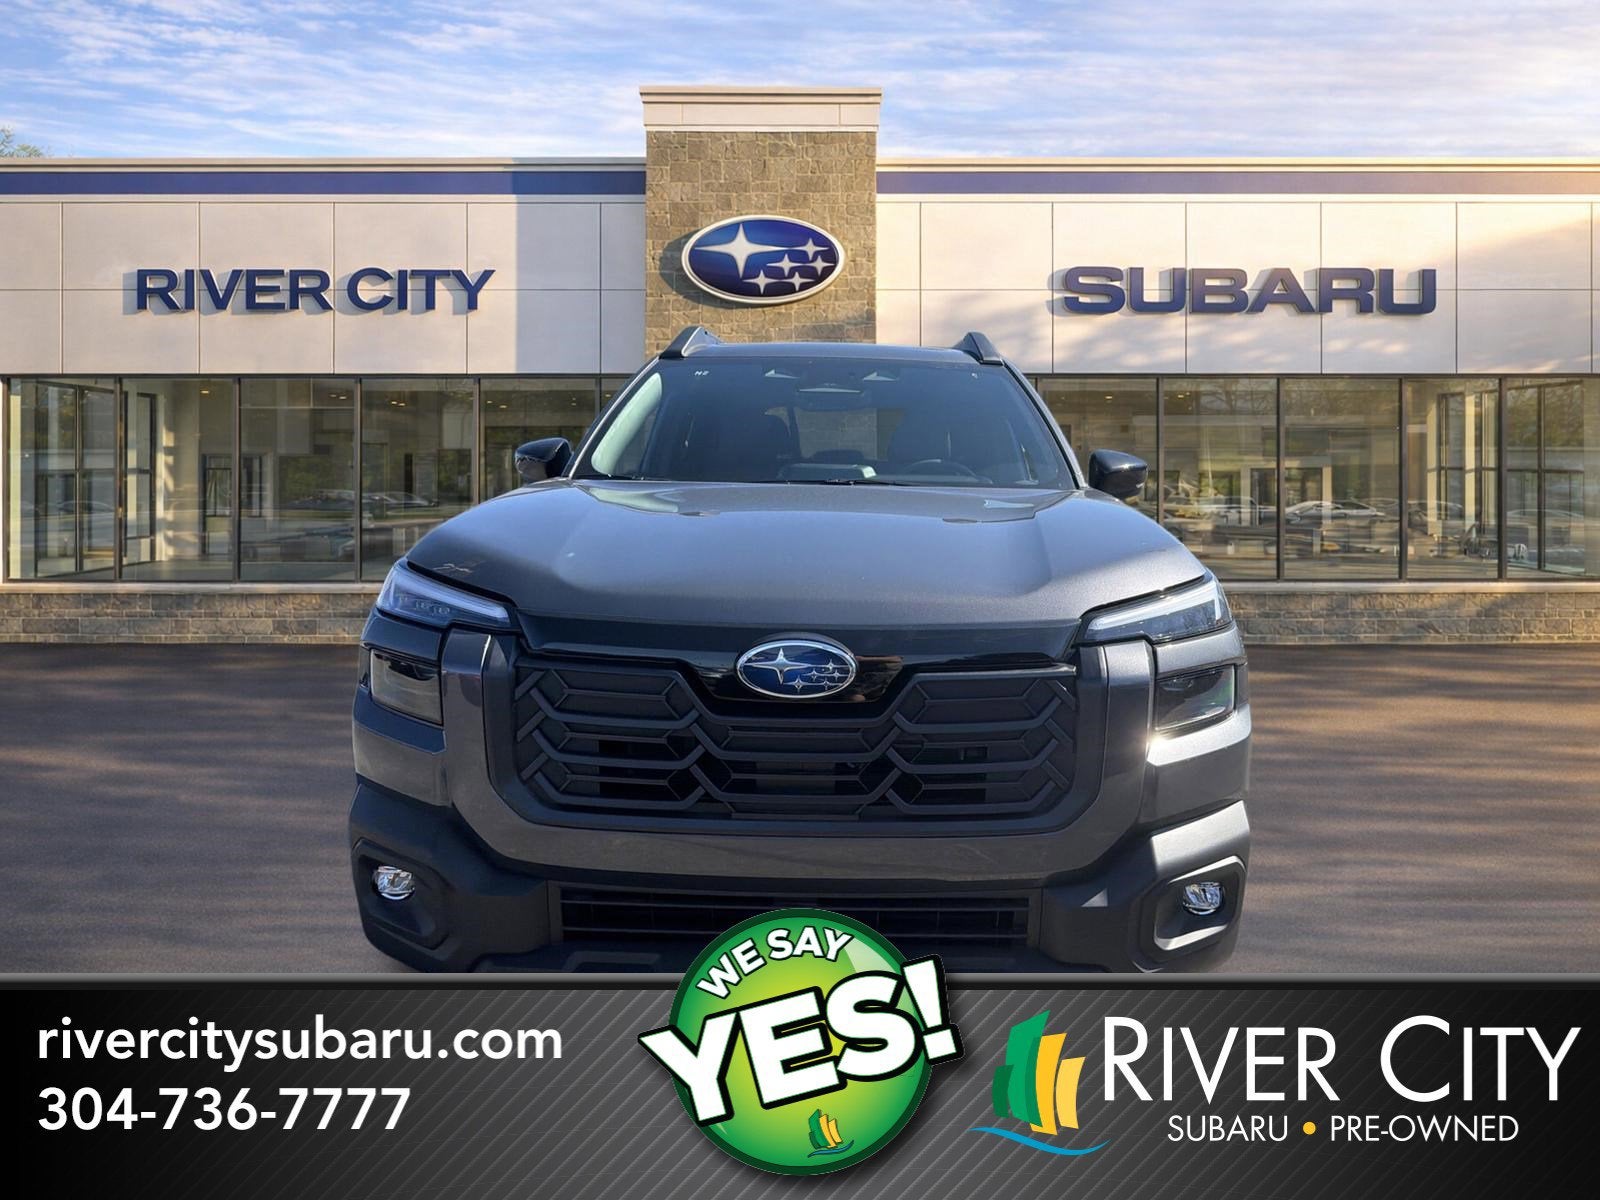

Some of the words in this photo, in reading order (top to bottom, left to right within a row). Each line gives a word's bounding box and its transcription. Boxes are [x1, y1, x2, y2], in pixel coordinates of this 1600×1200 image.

[136, 268, 333, 311] RIVER
[346, 266, 496, 312] CITY
[1062, 266, 1437, 315] SUBARU
